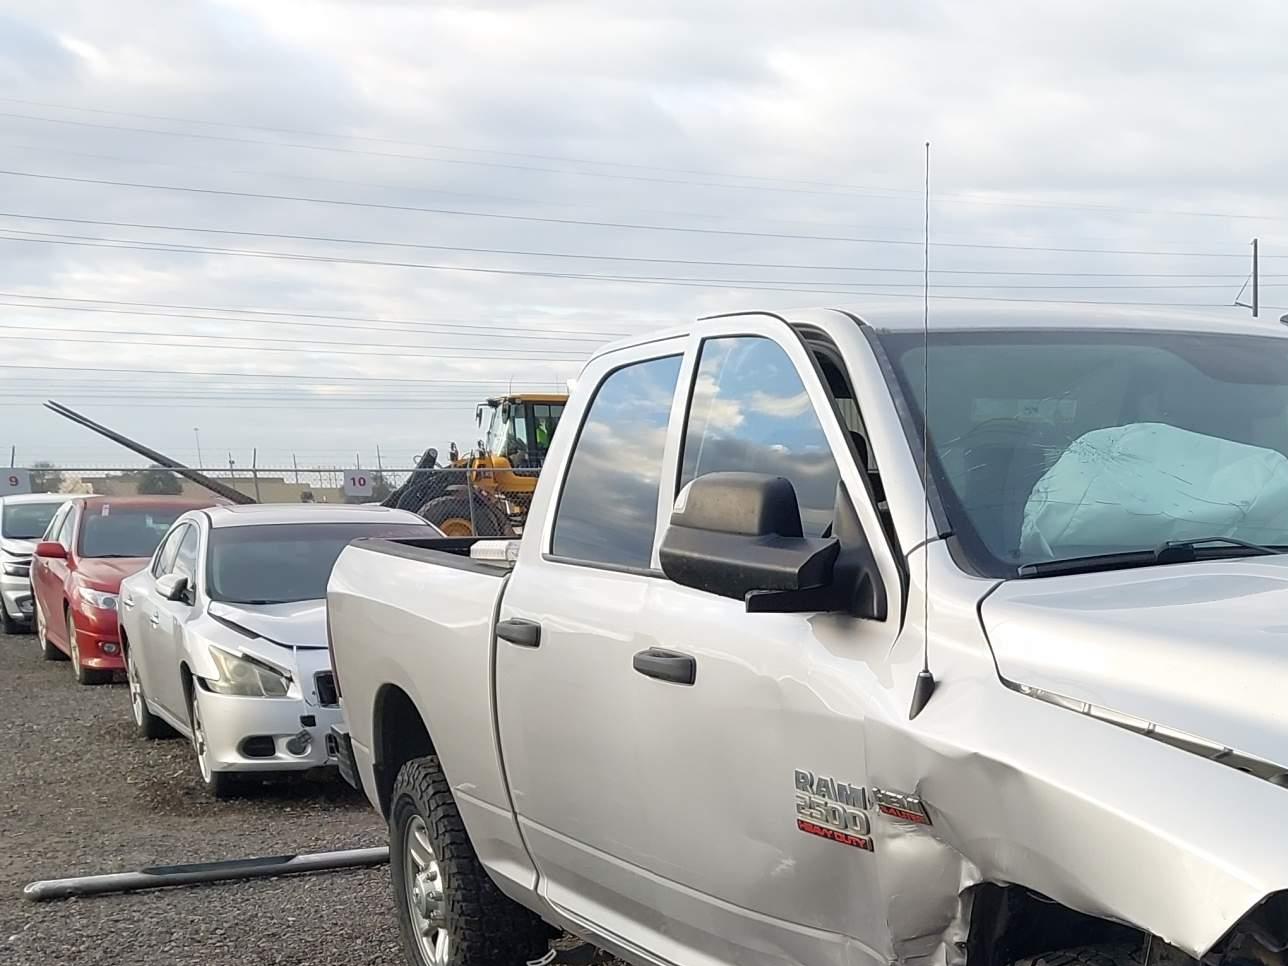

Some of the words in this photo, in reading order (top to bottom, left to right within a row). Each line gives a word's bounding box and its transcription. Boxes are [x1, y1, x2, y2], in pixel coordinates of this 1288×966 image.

[8, 475, 19, 487] 9
[350, 476, 367, 487] 10
[794, 767, 868, 811] RAM
[795, 792, 871, 837] 2500
[798, 820, 833, 837] HEAVY
[833, 831, 866, 849] DUTY
